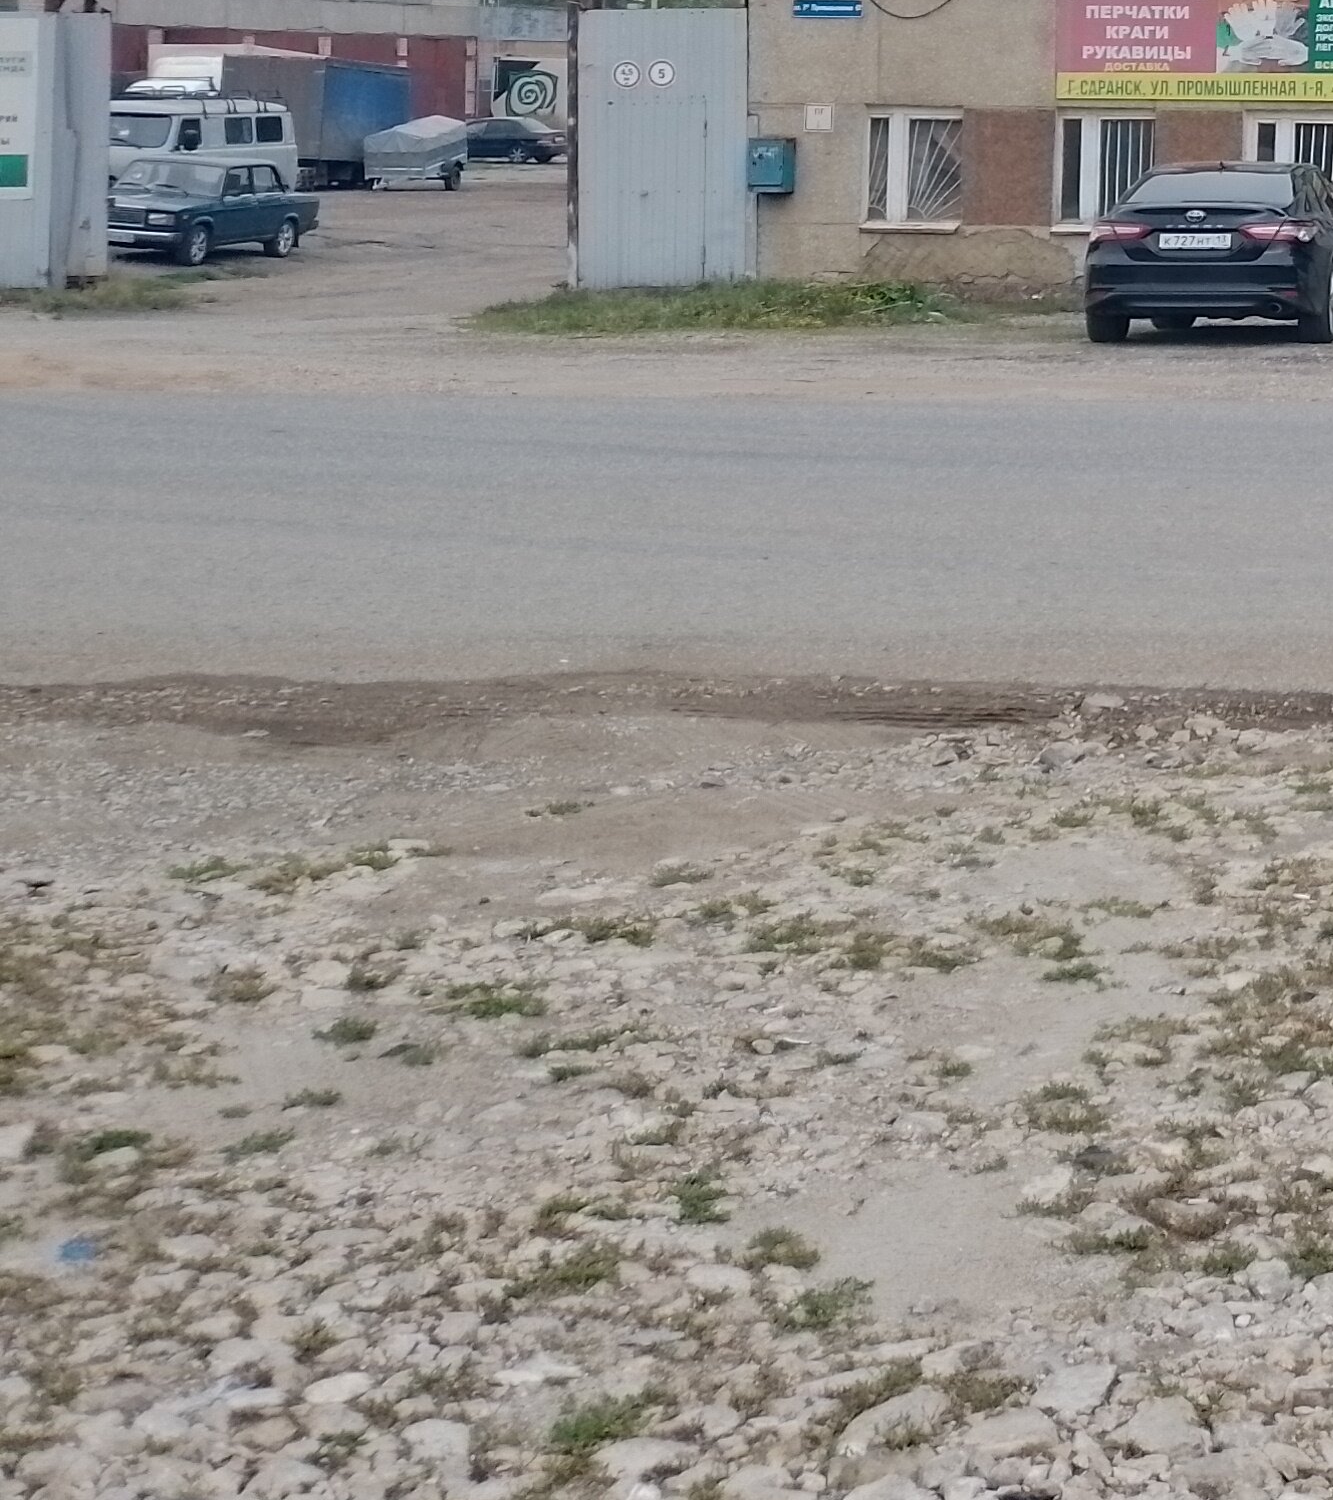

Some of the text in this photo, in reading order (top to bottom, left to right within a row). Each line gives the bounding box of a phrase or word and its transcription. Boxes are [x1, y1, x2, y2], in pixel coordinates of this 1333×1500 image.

[1085, 5, 1190, 20] ПЕРЧАТКИ
[1105, 25, 1169, 39] КРАГИ
[1082, 45, 1192, 60] РУКАВИЦЫ
[658, 68, 666, 79] 5
[1103, 62, 1170, 72] ДОСТАВКА
[1150, 81, 1172, 96] УЛ.
[1177, 80, 1296, 96] ПРОМЫШЛЕННАЯ
